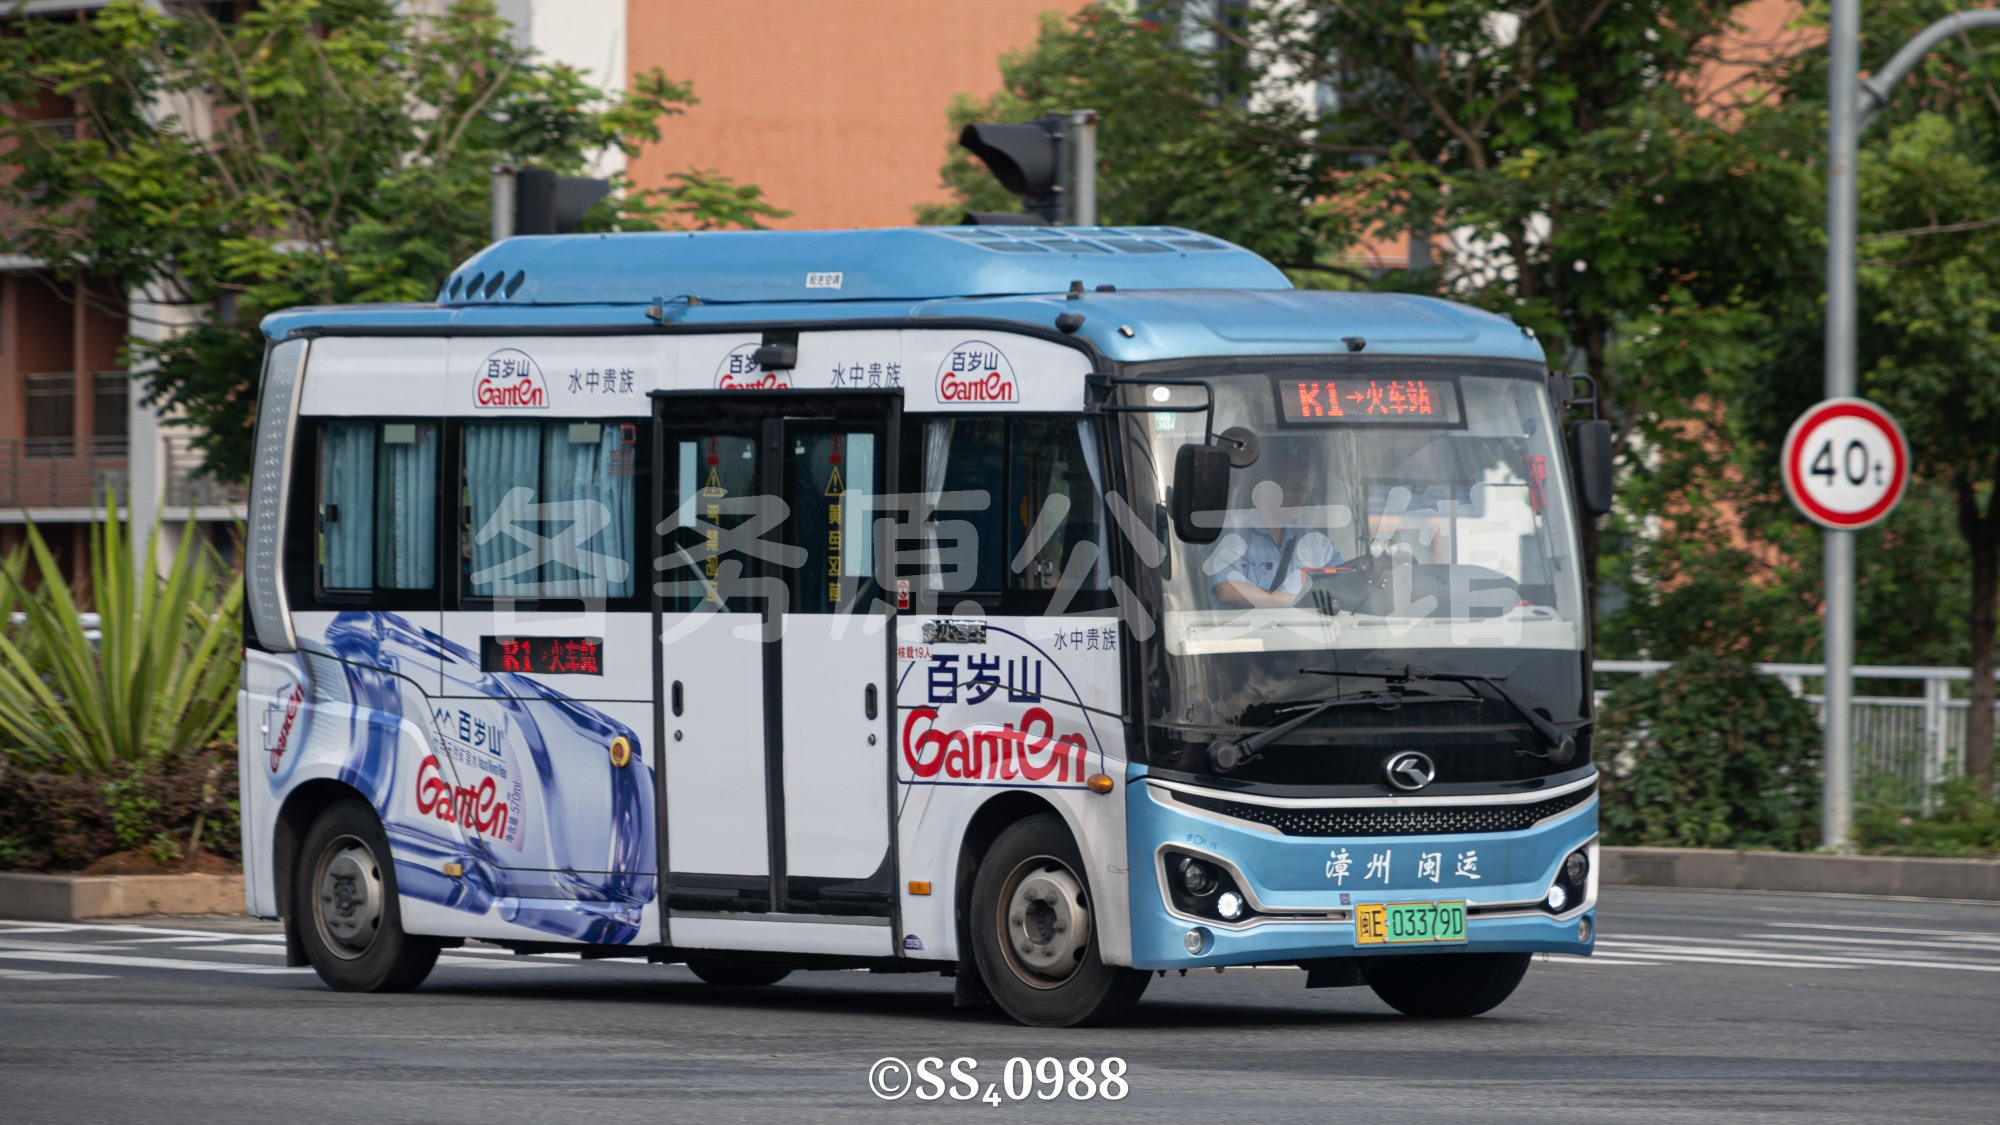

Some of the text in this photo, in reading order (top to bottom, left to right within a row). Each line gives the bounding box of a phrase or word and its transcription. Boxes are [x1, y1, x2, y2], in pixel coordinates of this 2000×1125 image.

[488, 359, 530, 378] 百岁山
[832, 362, 902, 388] 水中贵族
[952, 352, 998, 371] 百岁山
[568, 368, 634, 394] 水中贵族
[1298, 380, 1433, 417] K1 火车站
[1810, 439, 1884, 486] 40t
[897, 646, 932, 659] 核载19人
[1053, 627, 1117, 651] 水中贵族
[503, 640, 598, 673] K1 火车站
[927, 653, 1042, 706] 百岁山
[459, 708, 502, 757] 百岁山
[1325, 848, 1482, 886] 漳州 闽运
